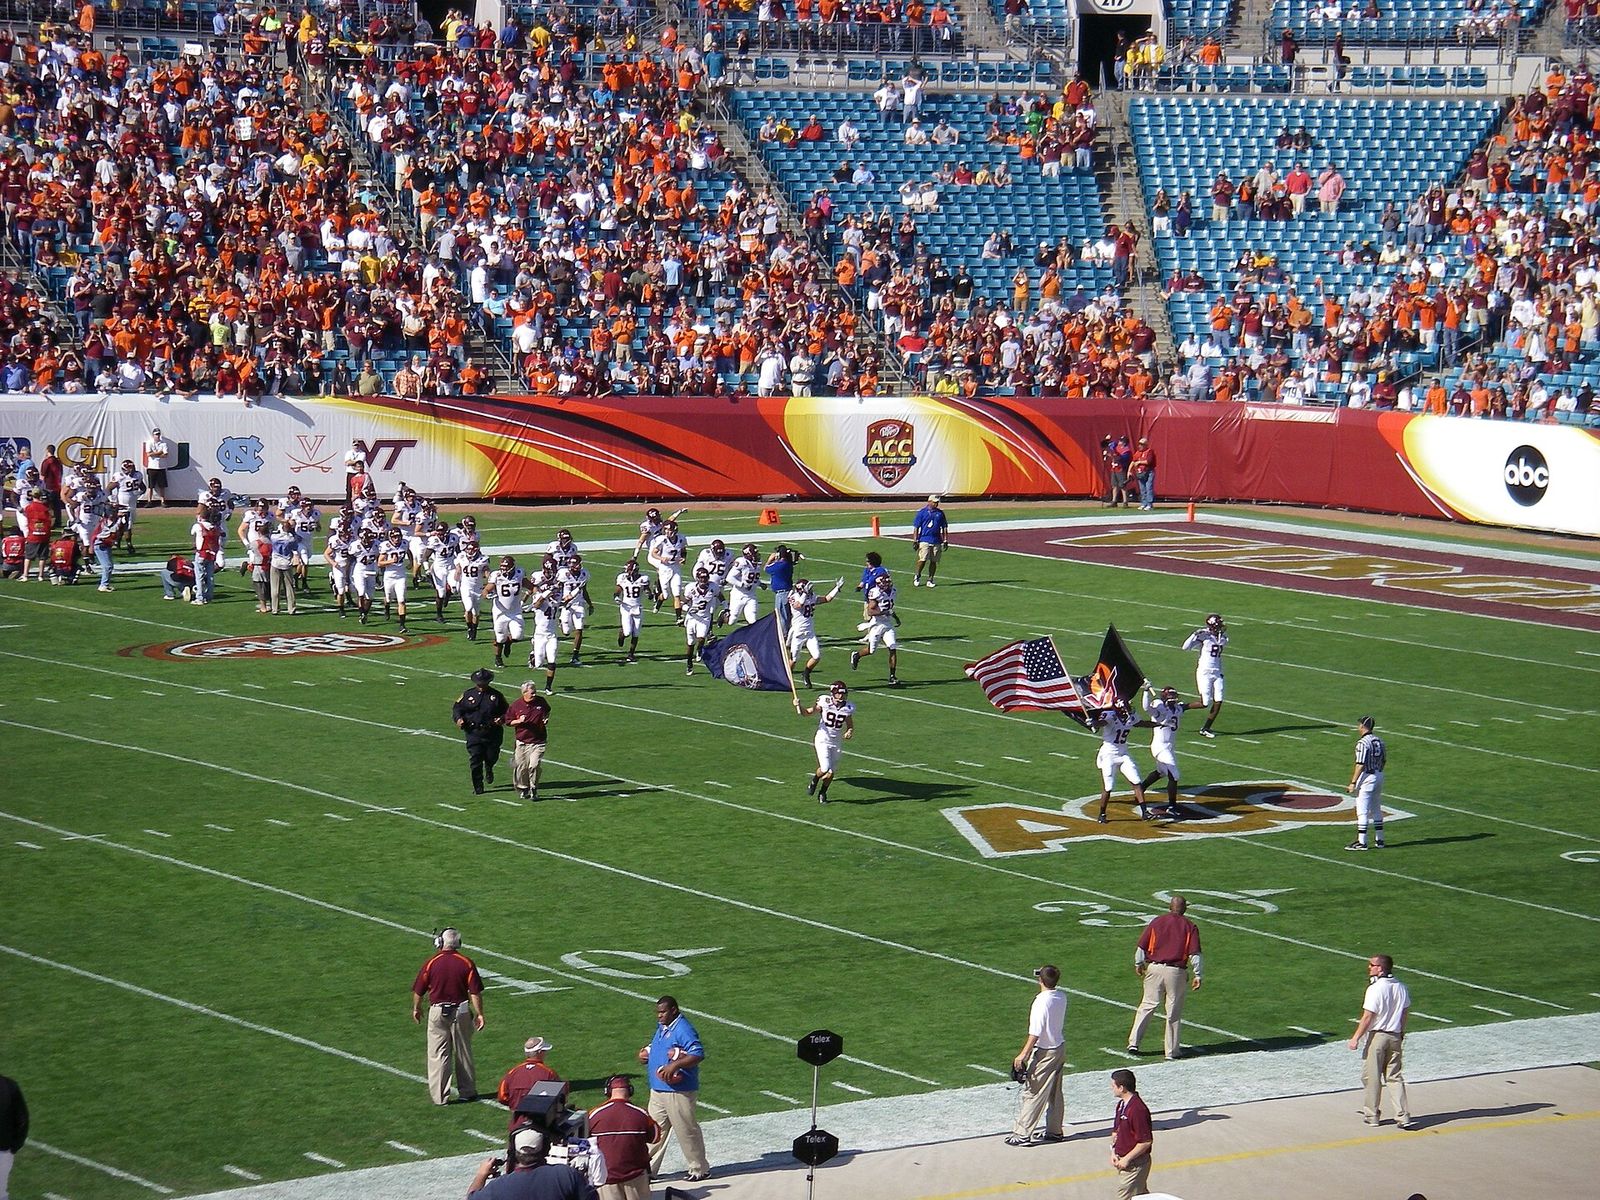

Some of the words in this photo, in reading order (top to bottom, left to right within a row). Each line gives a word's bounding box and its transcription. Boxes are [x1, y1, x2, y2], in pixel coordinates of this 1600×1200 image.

[868, 439, 912, 457] ACC
[1504, 457, 1549, 488] abc
[767, 511, 777, 523] G
[463, 566, 479, 577] 48
[501, 583, 521, 597] 67
[625, 586, 640, 598] 18
[698, 600, 708, 610] 3
[824, 711, 847, 729] 92
[1113, 728, 1130, 745] 19
[809, 1034, 831, 1044] Telex
[805, 1134, 826, 1144] Telex
